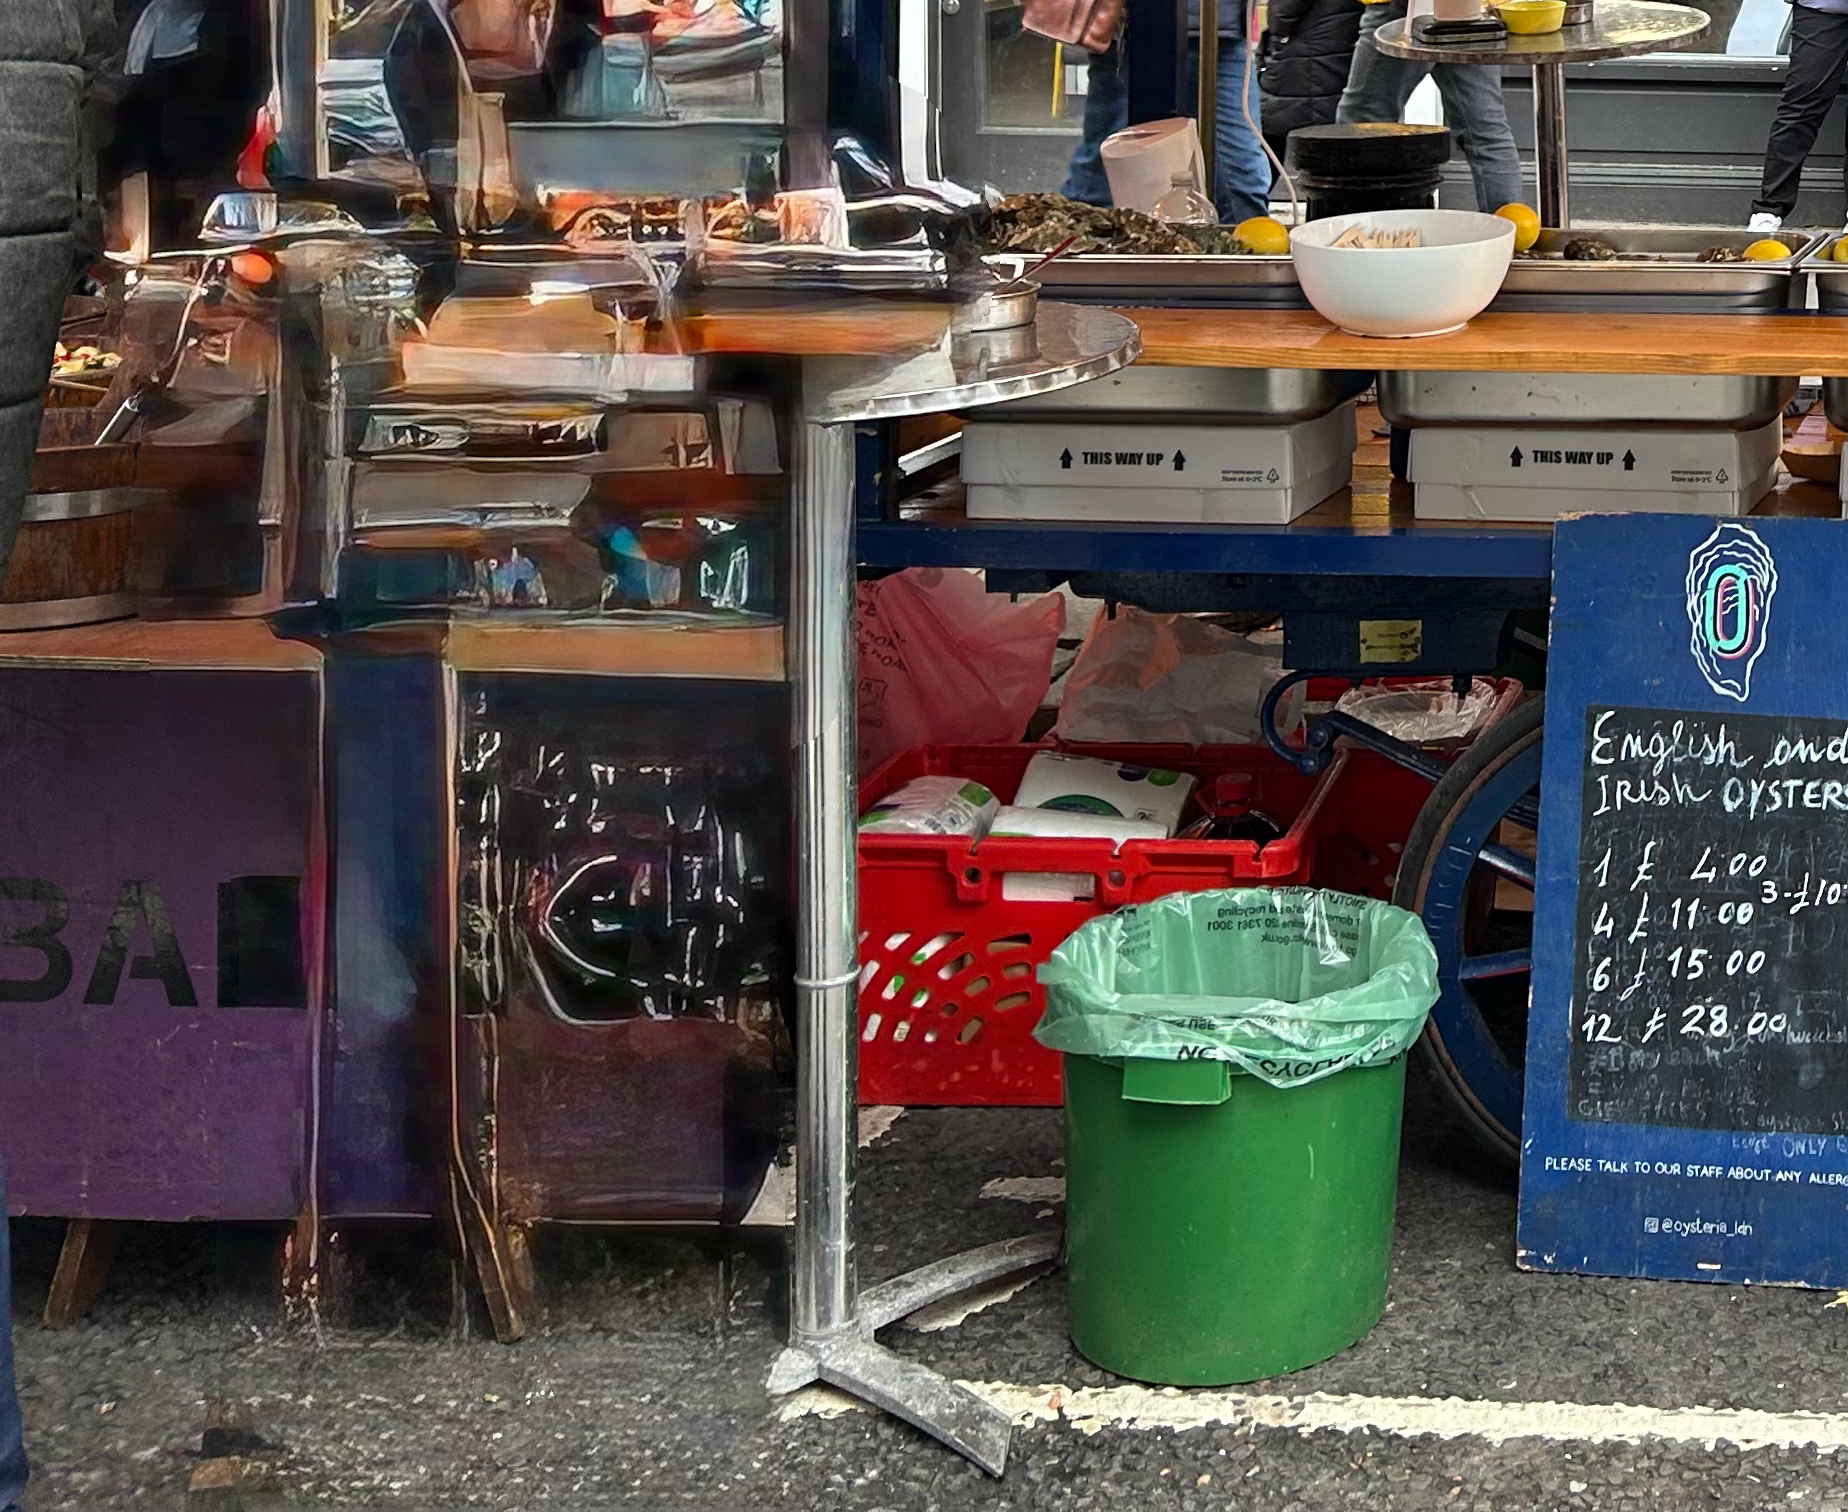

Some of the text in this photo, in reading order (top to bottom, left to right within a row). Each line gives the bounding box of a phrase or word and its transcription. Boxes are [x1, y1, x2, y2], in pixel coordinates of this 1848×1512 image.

[1082, 451, 1164, 467] THIS WAY UP
[1532, 450, 1614, 466] THIS WAY UP
[1591, 710, 1754, 775] English
[1593, 848, 1612, 888] 1
[1630, 841, 1656, 892] £
[1593, 902, 1614, 939] 4
[1628, 892, 1648, 944] £
[1593, 956, 1612, 992] 6
[1620, 947, 1648, 1002] £
[1581, 1013, 1622, 1043] 12
[1545, 1157, 1593, 1172] PLEASE
[1597, 1159, 1628, 1174] TALK
[1634, 1160, 1650, 1174] TO
[1654, 1161, 1681, 1175] OUR
[1687, 1164, 1723, 1179] STAFF
[1728, 1167, 1771, 1182] ABOUT
[1775, 1170, 1802, 1183] ANY
[1662, 1217, 1752, 1237] @oysteria_ldn
